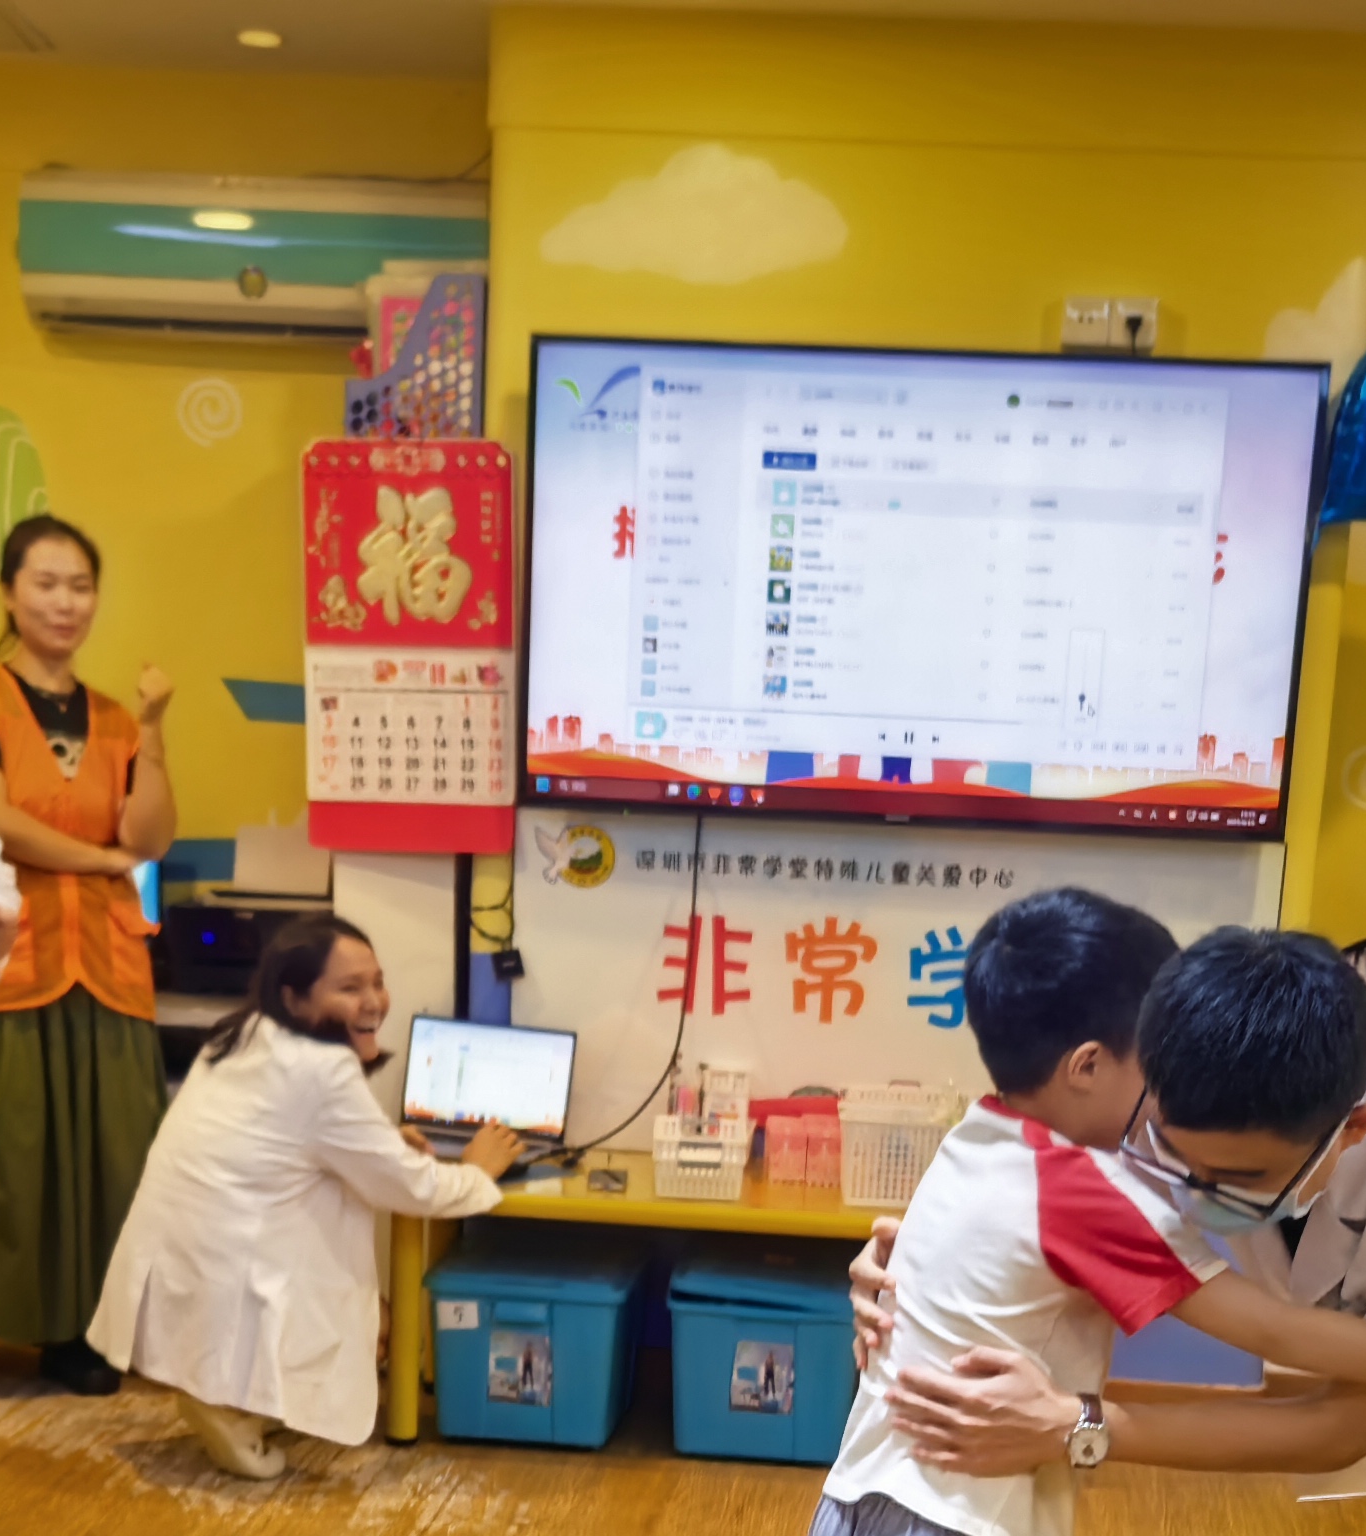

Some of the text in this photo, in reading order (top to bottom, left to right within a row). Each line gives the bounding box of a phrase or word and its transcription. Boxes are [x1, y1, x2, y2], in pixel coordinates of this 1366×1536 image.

[357, 485, 473, 626] 福
[352, 716, 360, 728] 4
[436, 716, 443, 729] 7
[350, 737, 363, 749] 11
[377, 736, 392, 750] 12
[405, 737, 419, 750] 13
[433, 736, 447, 749] 14
[635, 848, 1015, 890] 深圳市非常学堂特殊儿童关爱中心
